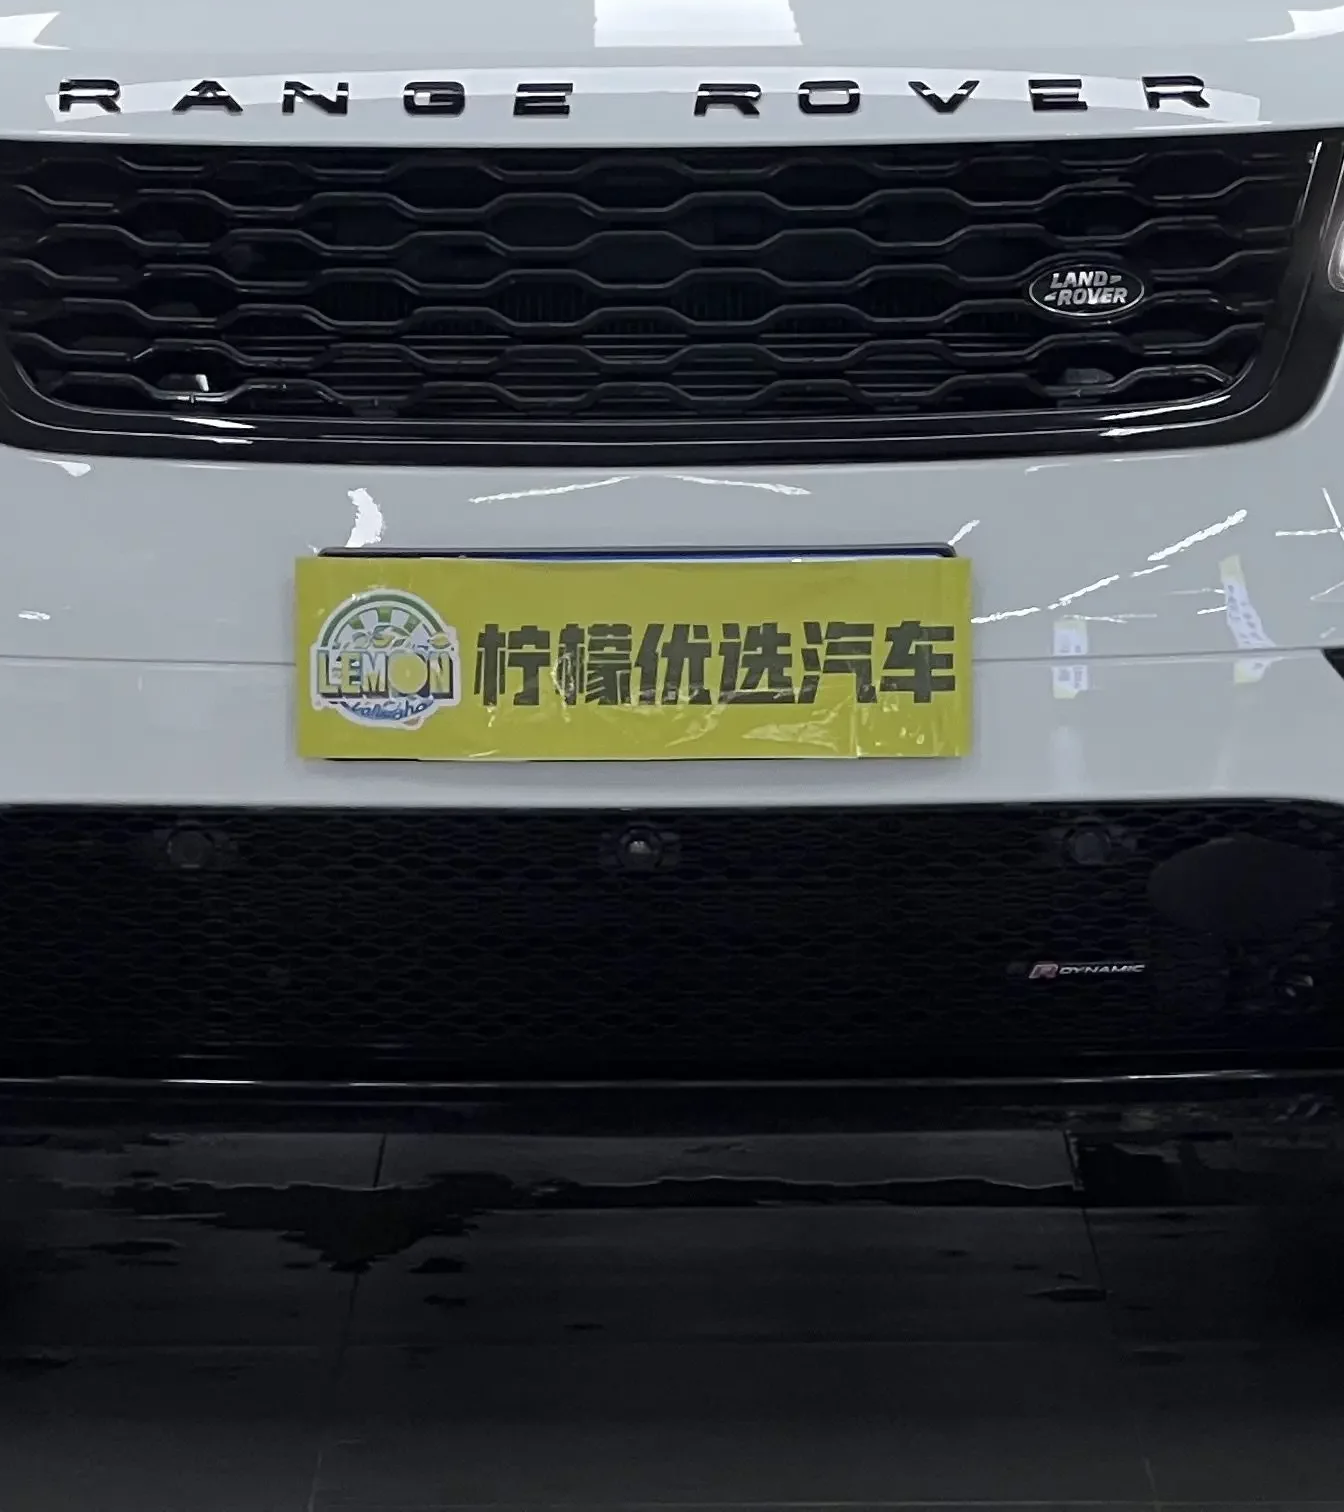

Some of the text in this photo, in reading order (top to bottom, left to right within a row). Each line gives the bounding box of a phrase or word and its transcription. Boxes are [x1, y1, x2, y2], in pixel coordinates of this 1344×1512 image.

[57, 75, 1210, 117] RANGE ROVER
[1050, 271, 1109, 288] LAND
[1057, 287, 1128, 306] ROVER
[317, 650, 454, 699] LEMON
[473, 620, 956, 706] 柠檬优选汽车
